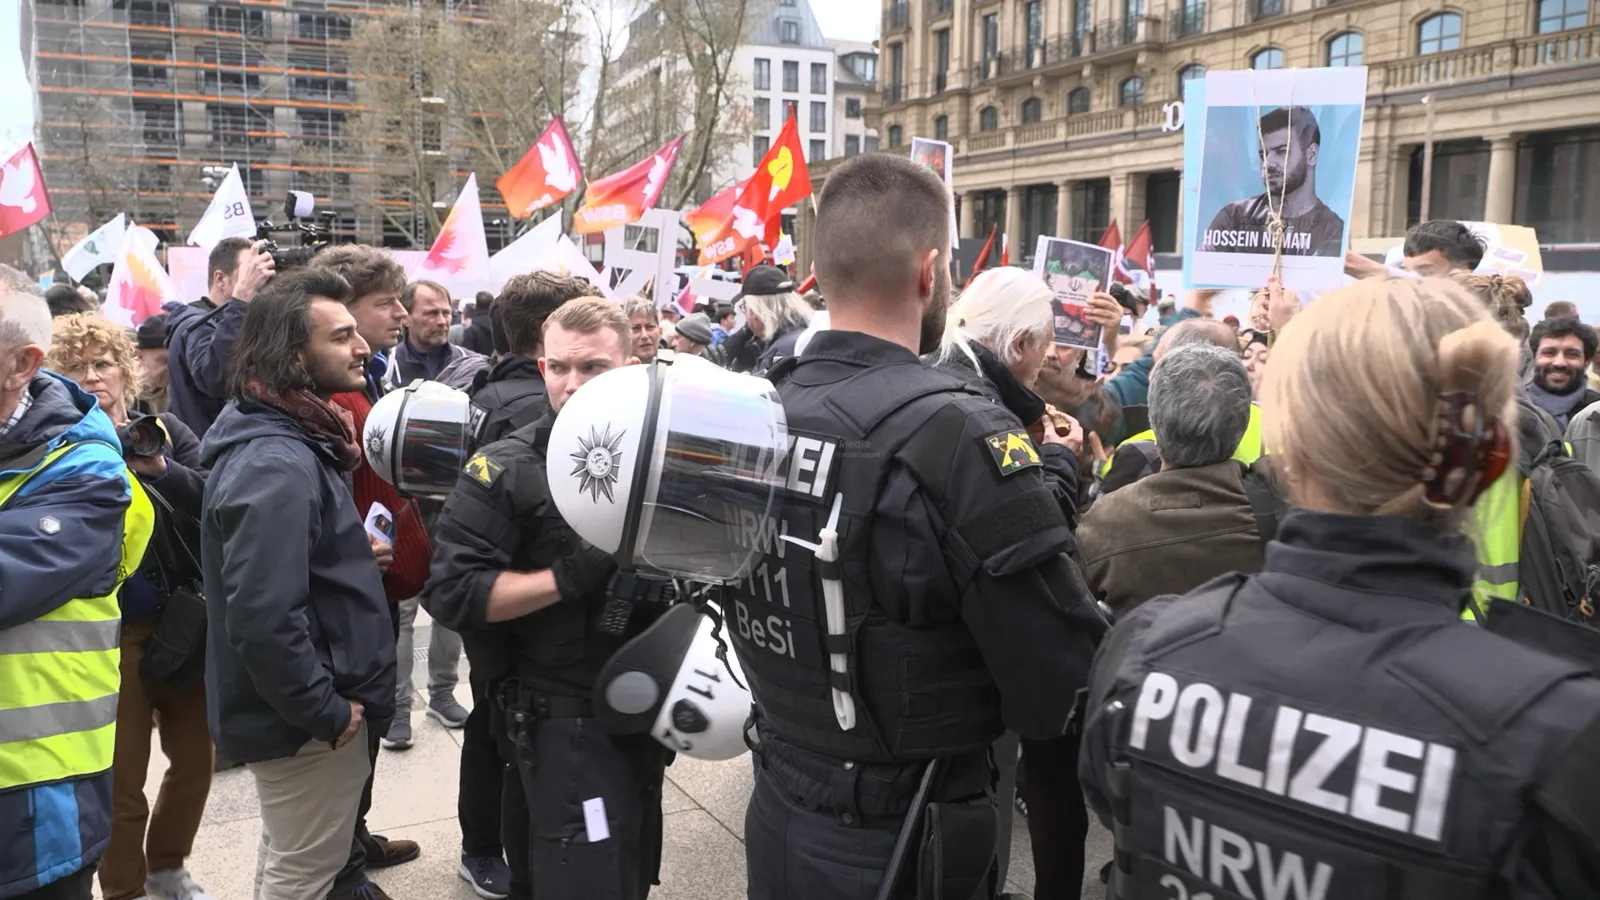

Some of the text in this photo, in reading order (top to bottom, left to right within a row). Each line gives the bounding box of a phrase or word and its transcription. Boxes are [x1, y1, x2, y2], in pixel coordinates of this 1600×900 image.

[1203, 229, 1312, 250] HOSSEIN NEMATI
[723, 503, 788, 559] NRW
[735, 599, 796, 659] BeSi
[1129, 672, 1457, 841] POLIZEI
[1164, 805, 1333, 900] NRW
